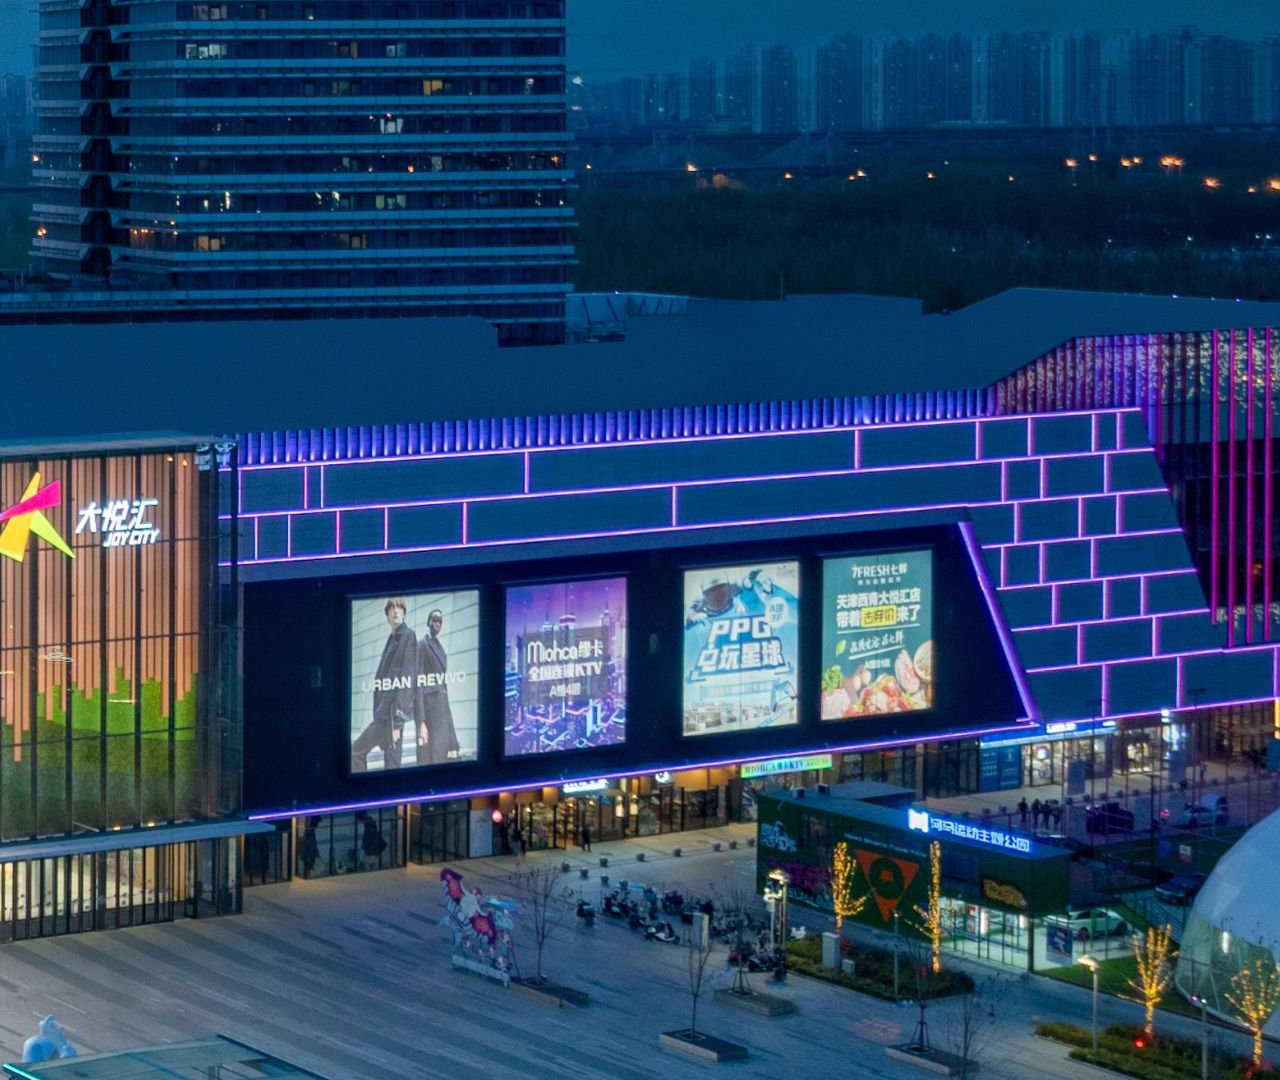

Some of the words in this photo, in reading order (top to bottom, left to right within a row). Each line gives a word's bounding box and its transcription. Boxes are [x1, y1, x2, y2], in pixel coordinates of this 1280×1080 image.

[75, 499, 159, 534] 大悦汇
[103, 531, 130, 547] JOY
[130, 529, 160, 545] CITY
[698, 640, 784, 672] 电玩星球
[361, 676, 412, 692] URBAN
[416, 671, 466, 688] REVIVO
